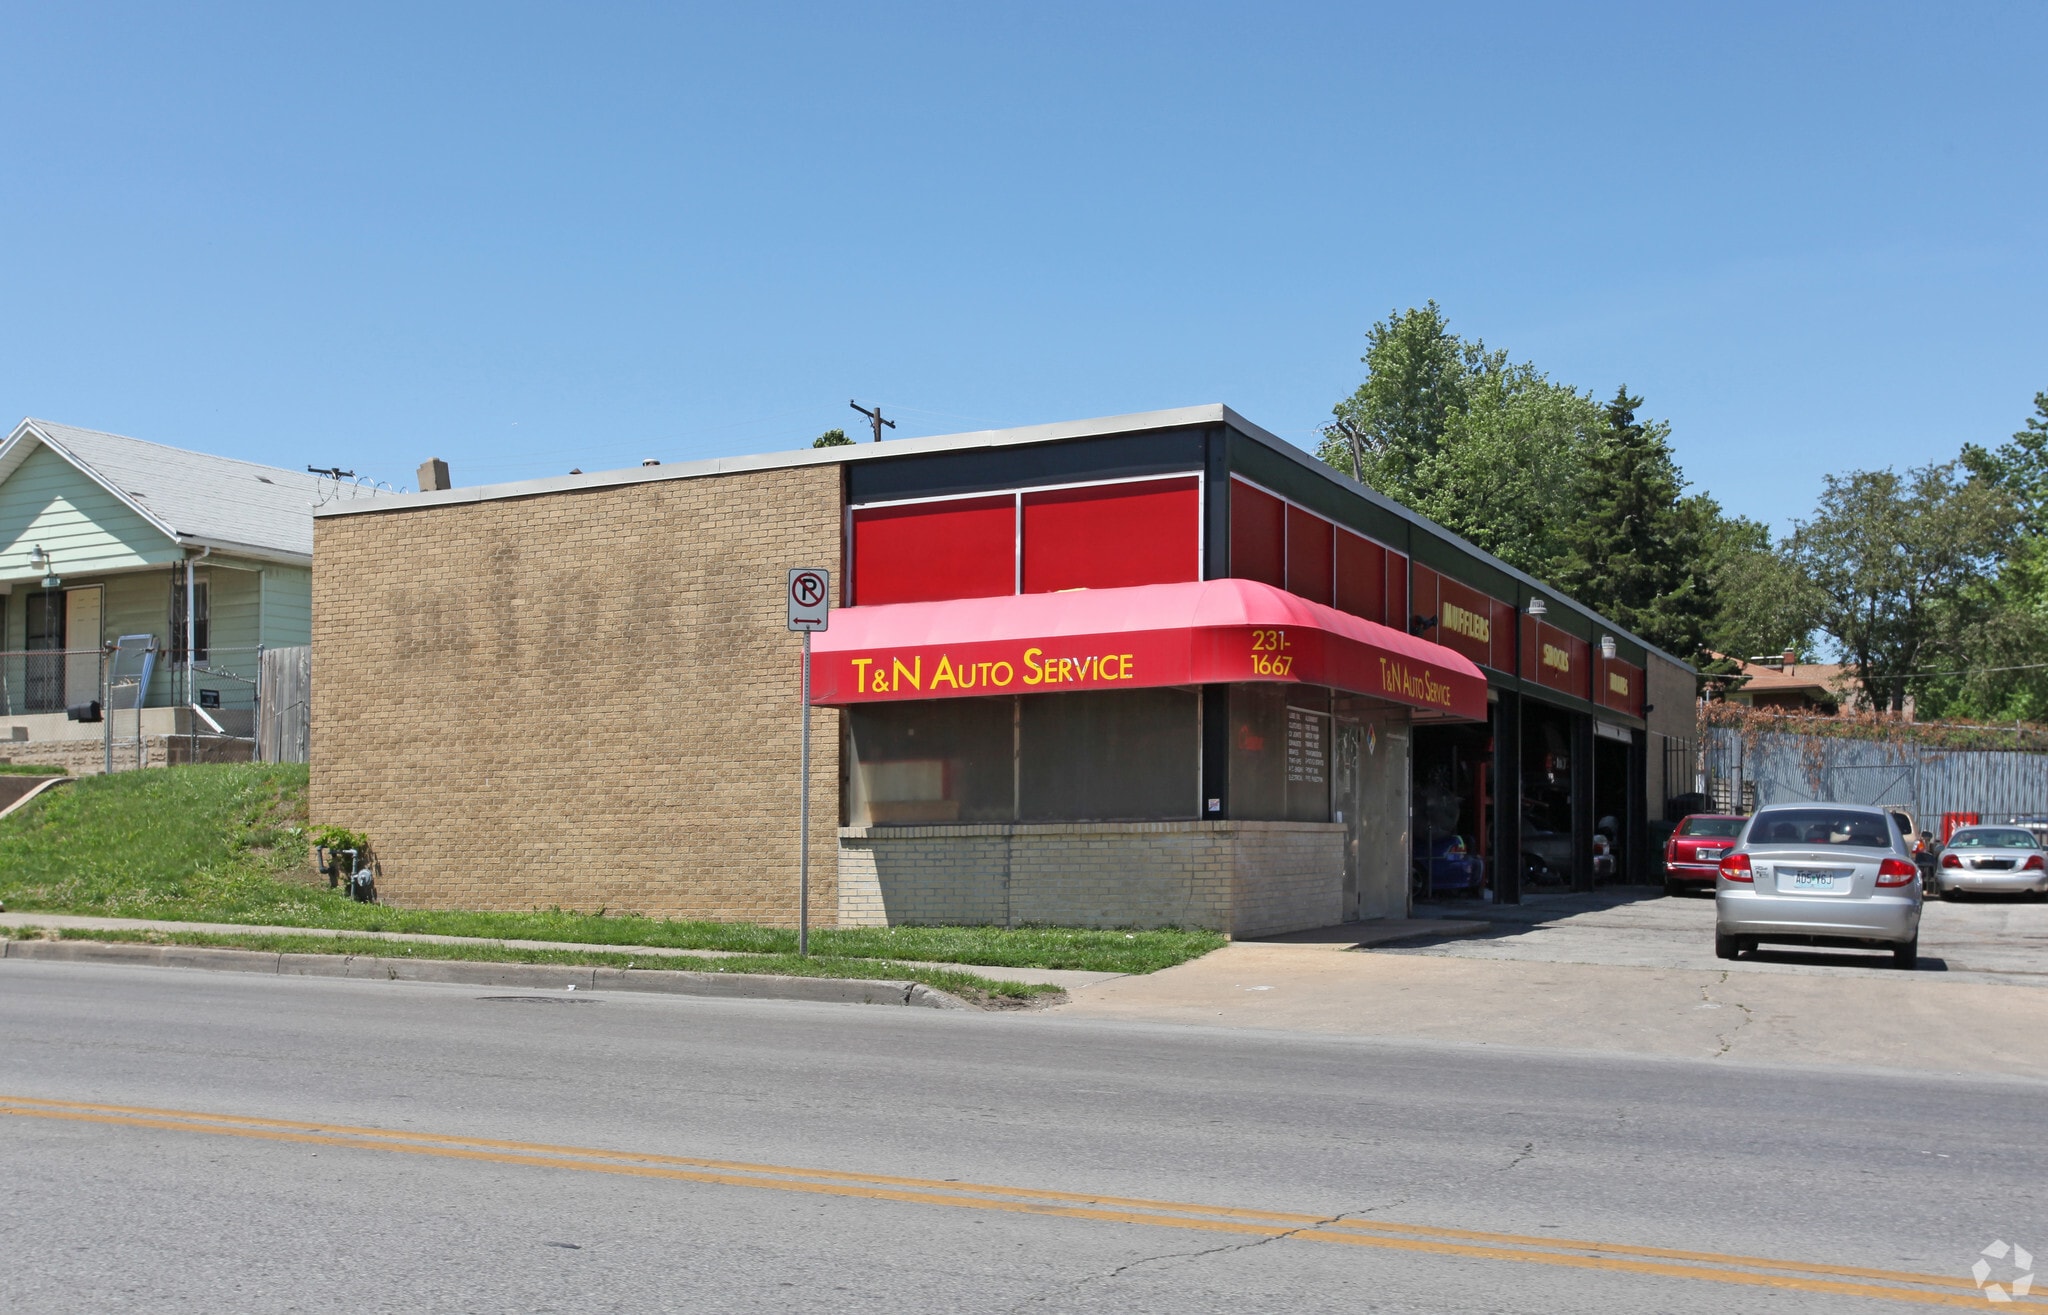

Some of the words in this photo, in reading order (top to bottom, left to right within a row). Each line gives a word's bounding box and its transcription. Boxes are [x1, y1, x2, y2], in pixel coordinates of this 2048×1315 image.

[1252, 630, 1291, 651] 231-
[1442, 602, 1490, 643] MUFFLERS
[851, 655, 921, 693] T&N
[929, 653, 1014, 690] AUTO
[1022, 647, 1134, 685] SERVICE
[1250, 654, 1293, 676] 1667
[1380, 657, 1401, 693] T&N
[1403, 665, 1425, 700] AUTO
[1424, 670, 1451, 706] SERVICE
